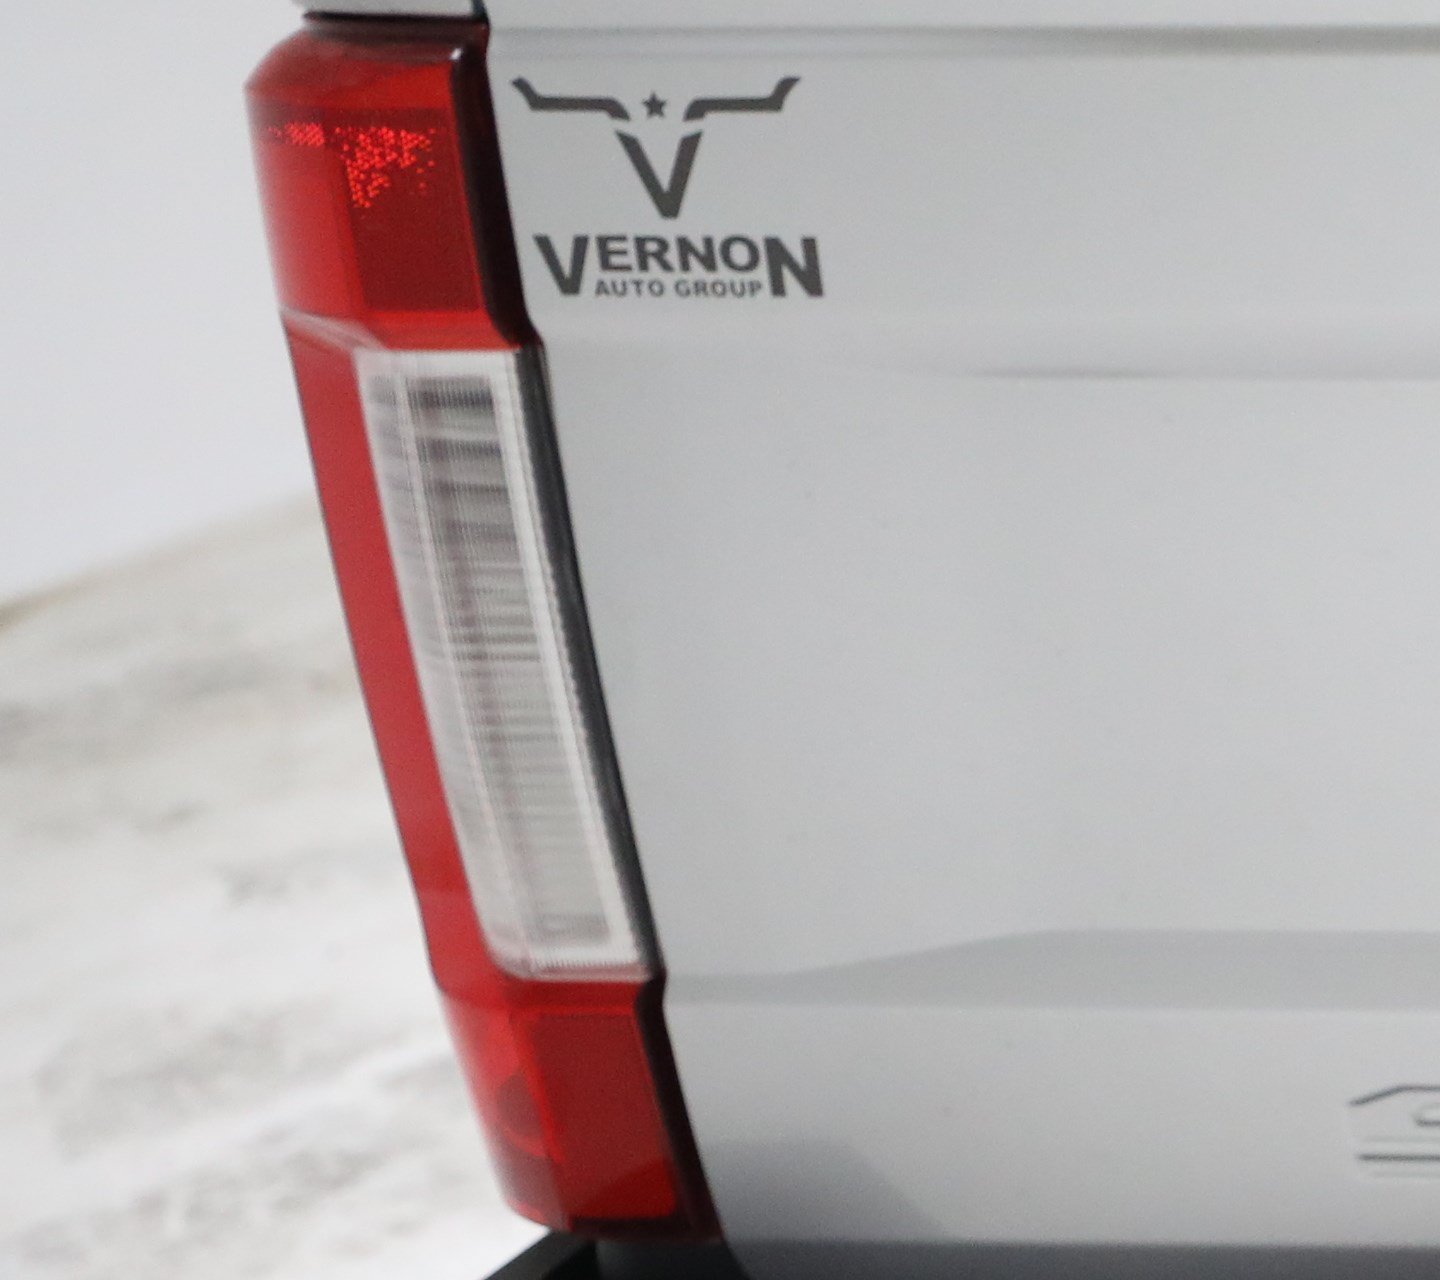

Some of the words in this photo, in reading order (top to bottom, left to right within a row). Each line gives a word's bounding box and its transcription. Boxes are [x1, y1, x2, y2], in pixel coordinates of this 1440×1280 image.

[533, 234, 824, 297] VERNON
[594, 279, 665, 298] AUTO
[673, 279, 762, 298] GROUP
